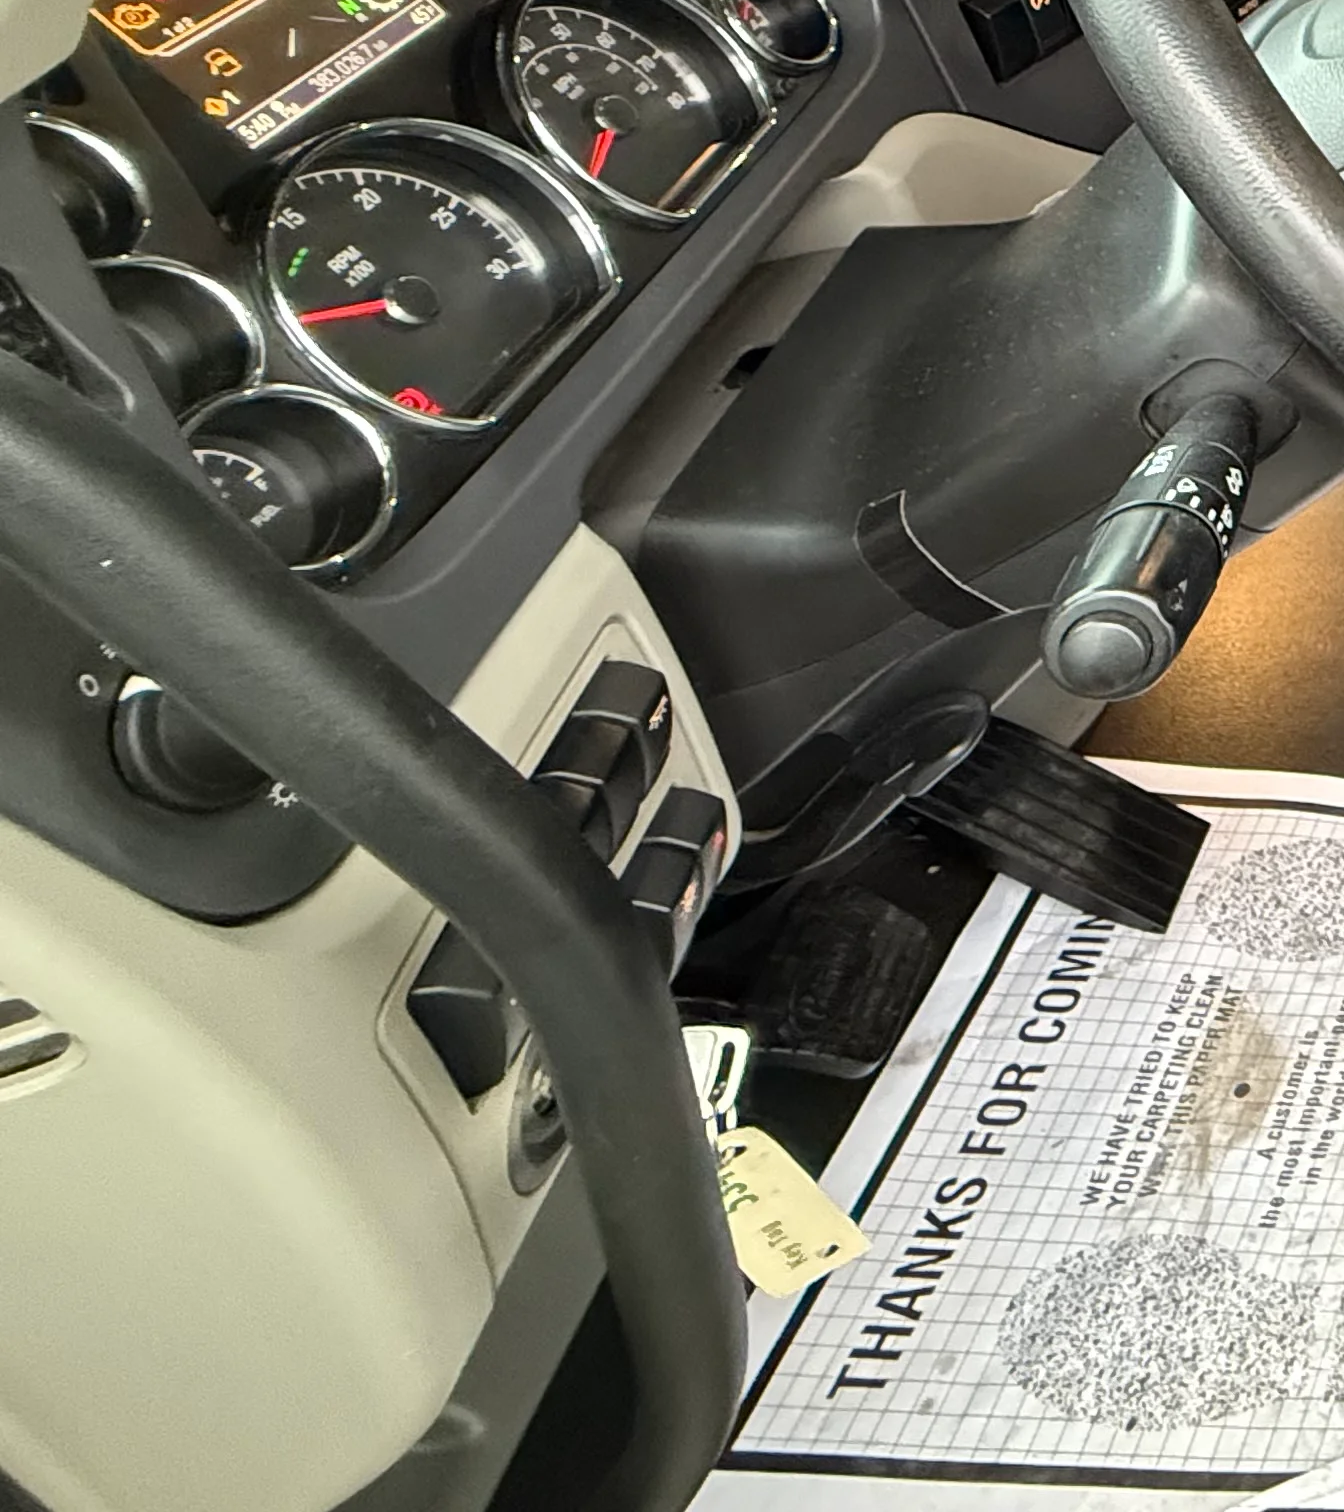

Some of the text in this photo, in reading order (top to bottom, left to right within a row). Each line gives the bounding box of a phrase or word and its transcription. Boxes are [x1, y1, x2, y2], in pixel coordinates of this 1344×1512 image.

[236, 112, 277, 142] 5:40
[352, 187, 382, 212] 20
[276, 207, 306, 231] 15
[430, 206, 458, 231] 25
[326, 245, 364, 275] RPM
[484, 257, 511, 281] 30
[1163, 1092, 1197, 1138] THIS
[1185, 1027, 1227, 1089] PAPER
[1213, 984, 1244, 1023] MAT
[1080, 973, 1197, 1206] WE HAVE TRIED TO KEEP
[1105, 974, 1224, 1210] YOUR CARPETING CLEAN
[1257, 1030, 1319, 1161] A customer is
[1258, 1196, 1286, 1229] the
[1277, 1139, 1306, 1188] most
[1292, 1041, 1341, 1132] important
[1310, 1129, 1335, 1160] the
[826, 914, 1115, 1400] THANKS FOR COMIN
[1299, 1166, 1323, 1186] in
